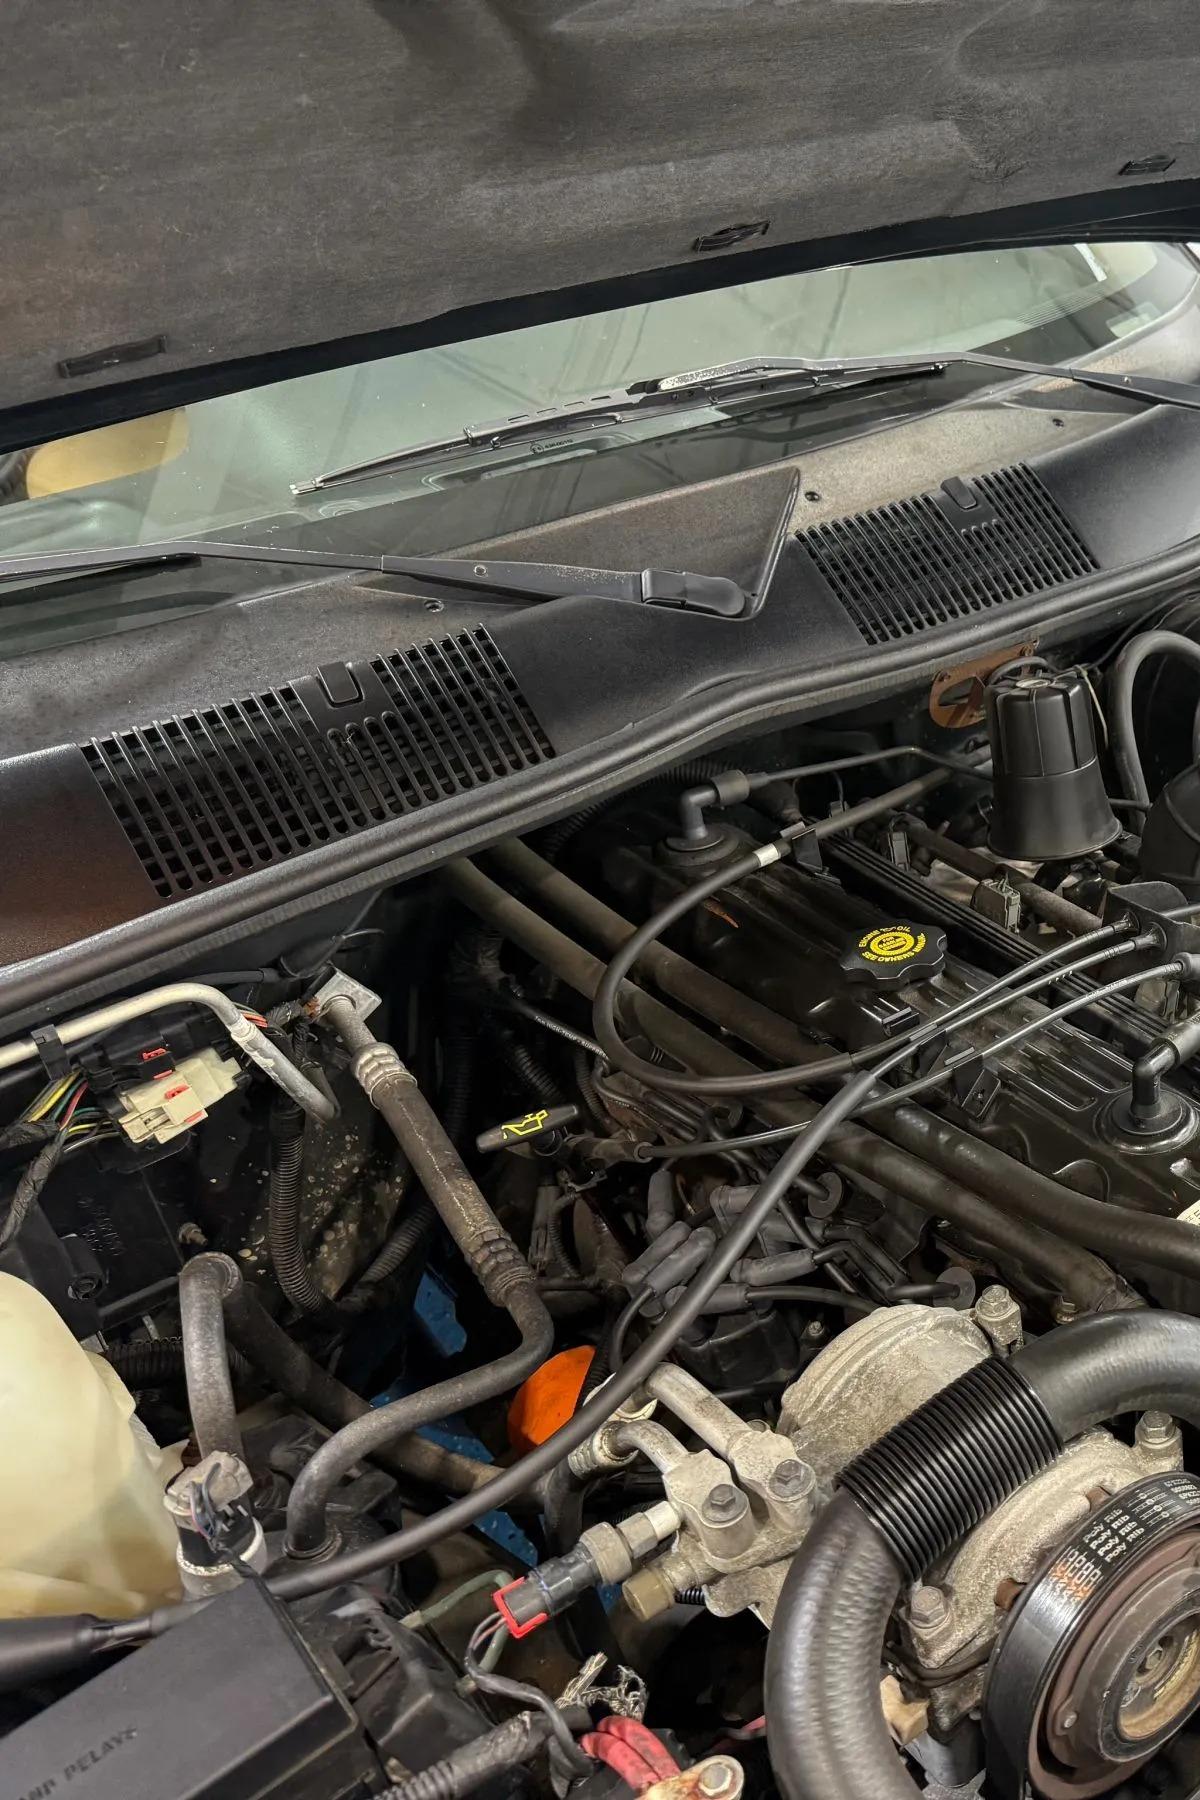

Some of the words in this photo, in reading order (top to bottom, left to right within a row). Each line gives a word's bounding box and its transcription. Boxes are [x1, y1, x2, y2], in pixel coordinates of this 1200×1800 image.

[862, 951, 879, 961] SEE
[1103, 1505, 1122, 1524] Rib
[1110, 1512, 1130, 1530] Rib
[1118, 1518, 1138, 1537] Rib
[1125, 1524, 1145, 1543] Rib
